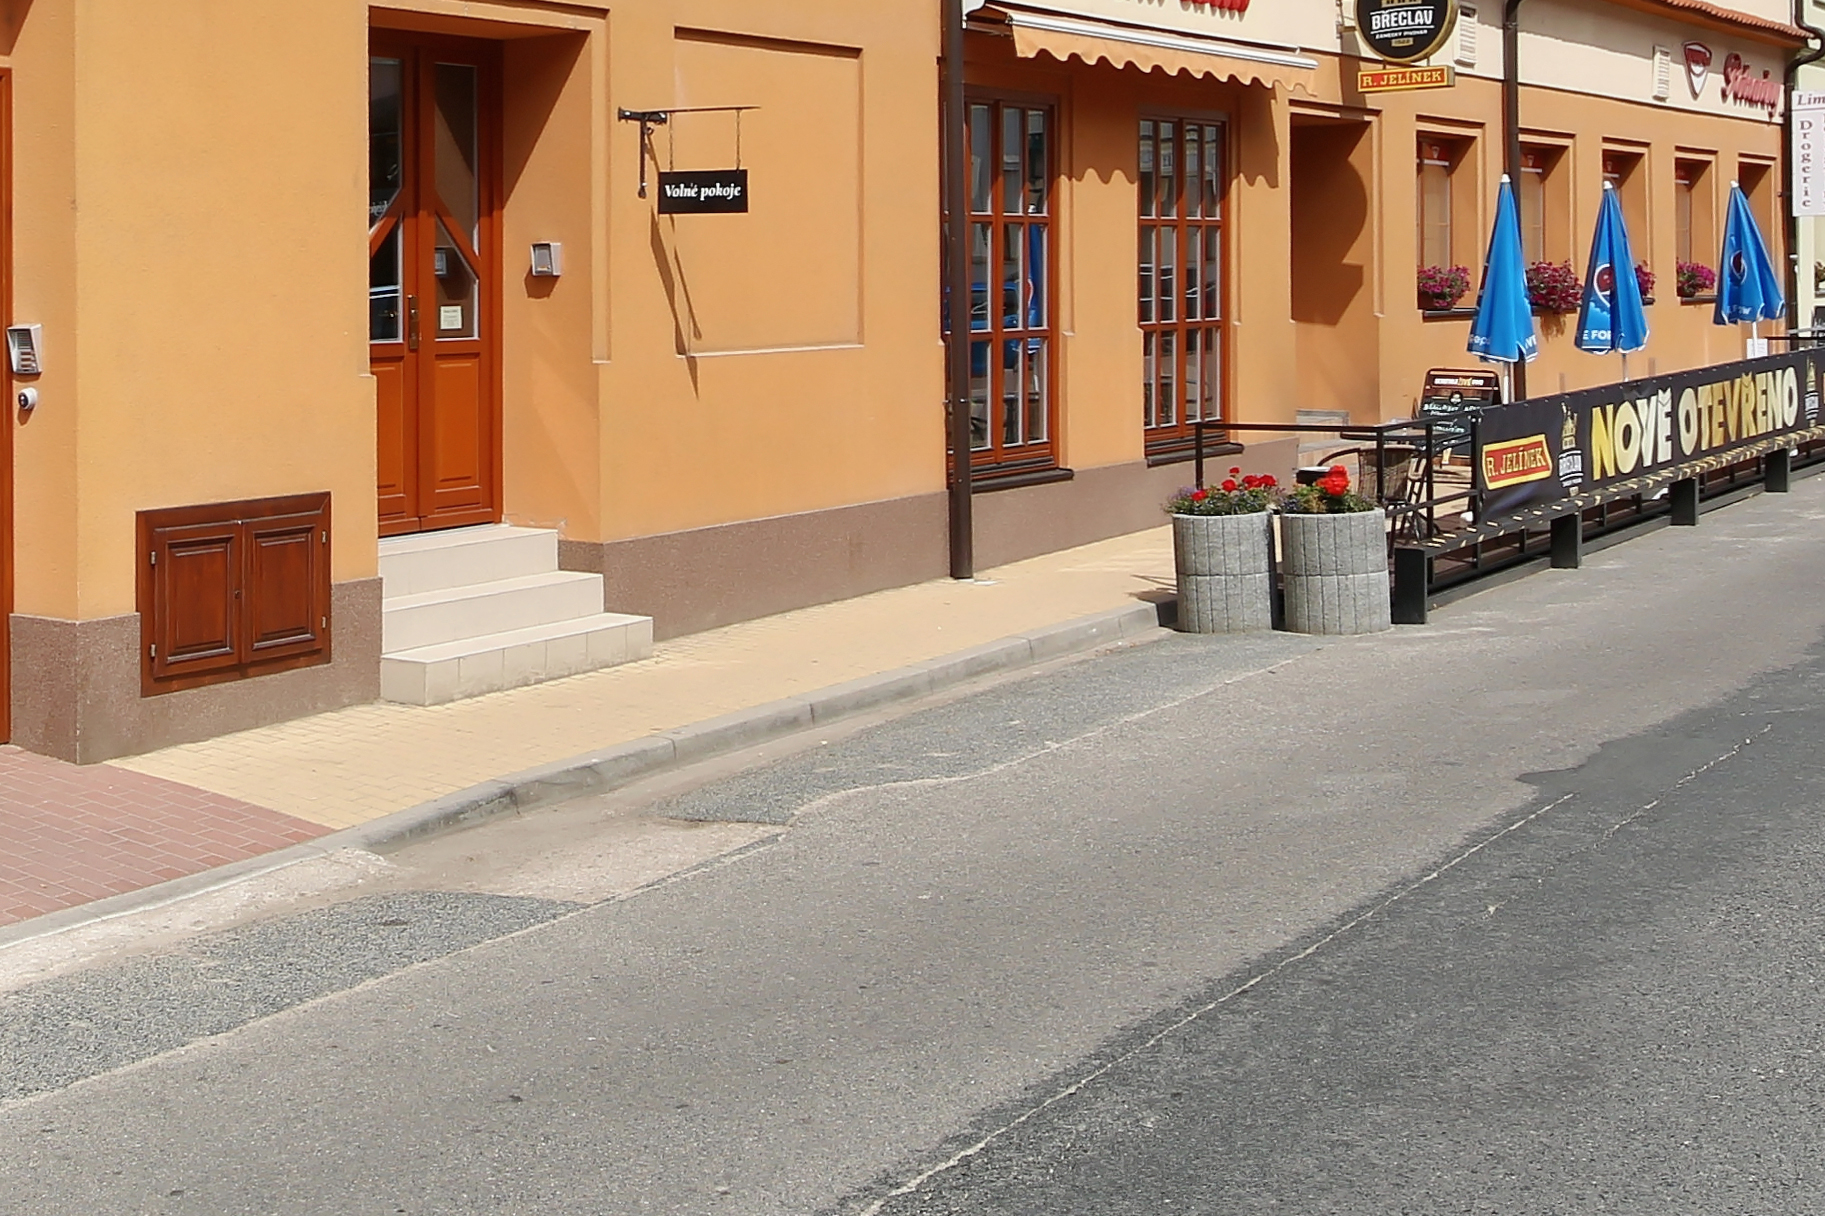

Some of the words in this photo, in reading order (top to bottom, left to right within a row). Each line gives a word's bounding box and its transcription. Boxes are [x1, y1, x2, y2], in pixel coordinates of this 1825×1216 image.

[1371, 10, 1433, 30] BŘECLAV
[1362, 76, 1377, 87] R.
[1380, 71, 1442, 85] JELÍNEK
[664, 182, 698, 197] Volné
[700, 182, 741, 201] pokoje
[1677, 366, 1798, 457] OTEVŘENO
[1486, 457, 1498, 477] R.
[1500, 447, 1546, 475] JELÍNEK
